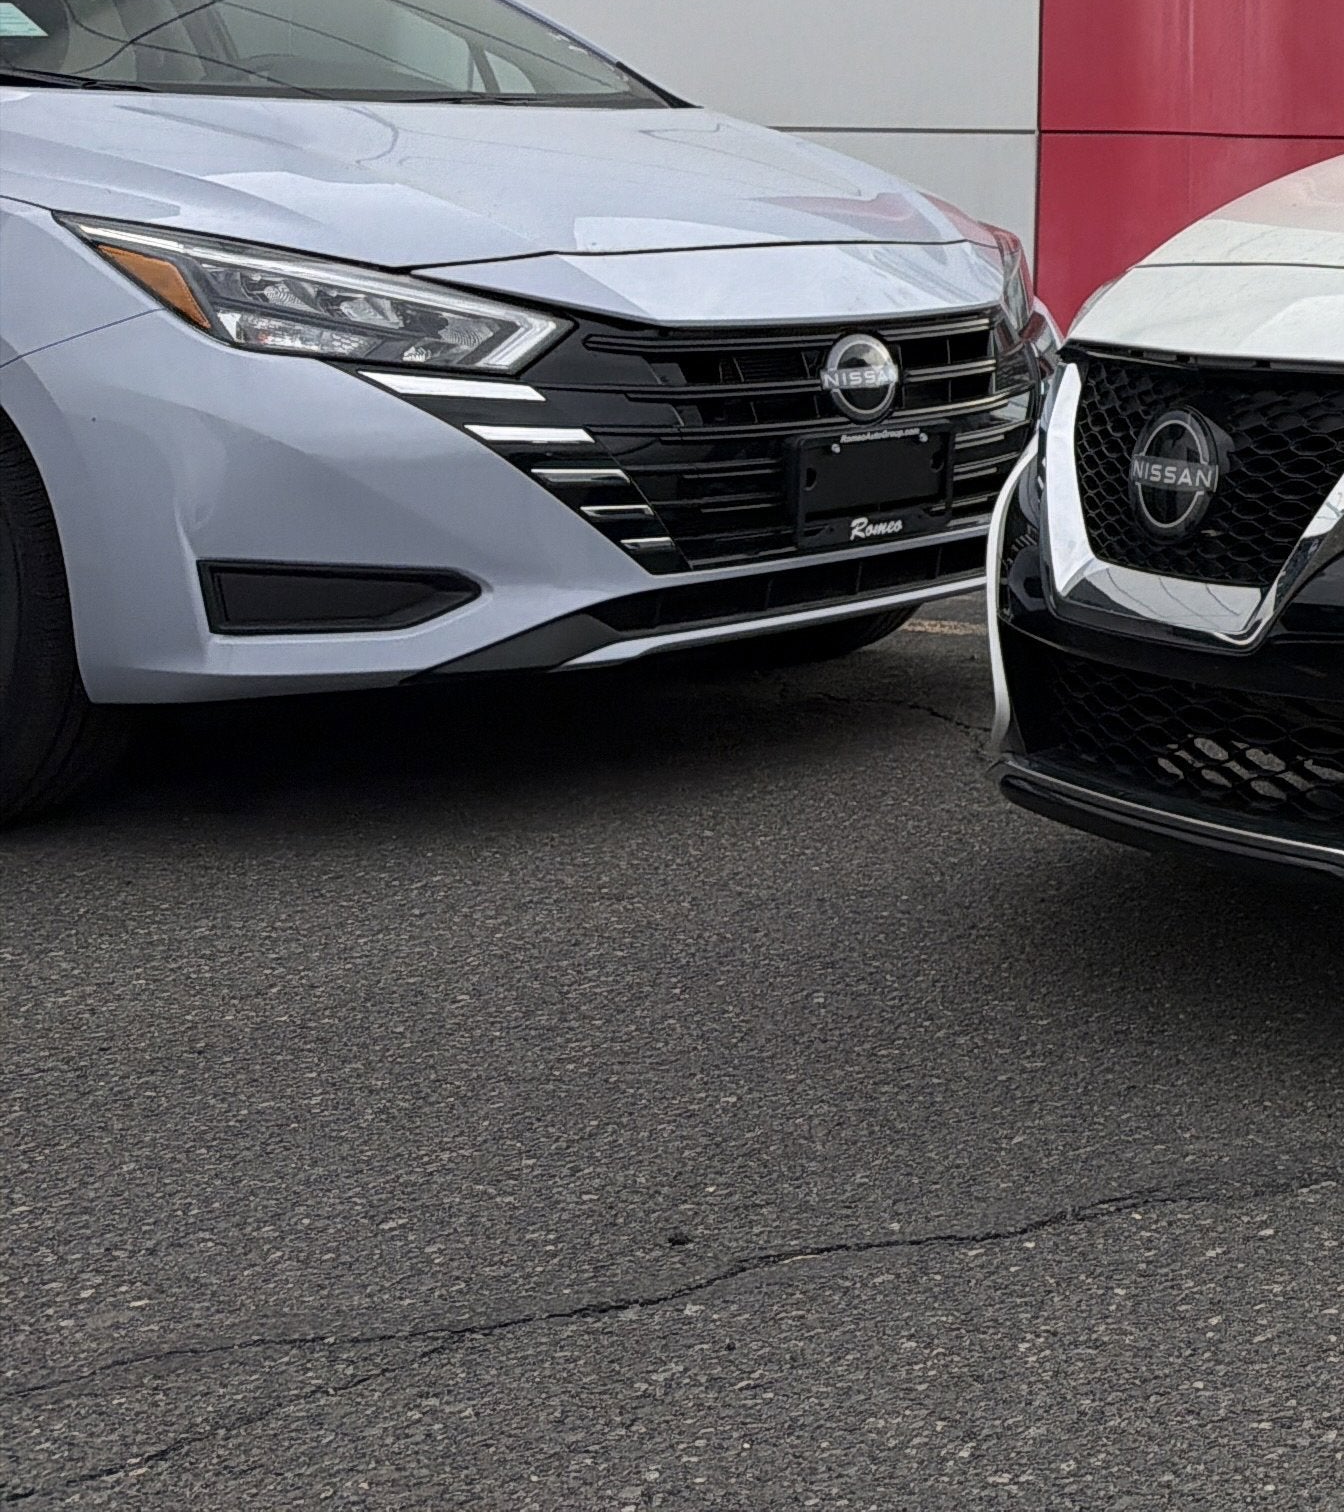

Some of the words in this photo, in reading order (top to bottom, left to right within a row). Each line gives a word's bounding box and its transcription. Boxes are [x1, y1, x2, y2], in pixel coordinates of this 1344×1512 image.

[823, 369, 898, 387] NISSAN
[1132, 459, 1212, 488] NISSAN
[849, 516, 903, 541] Romeo
